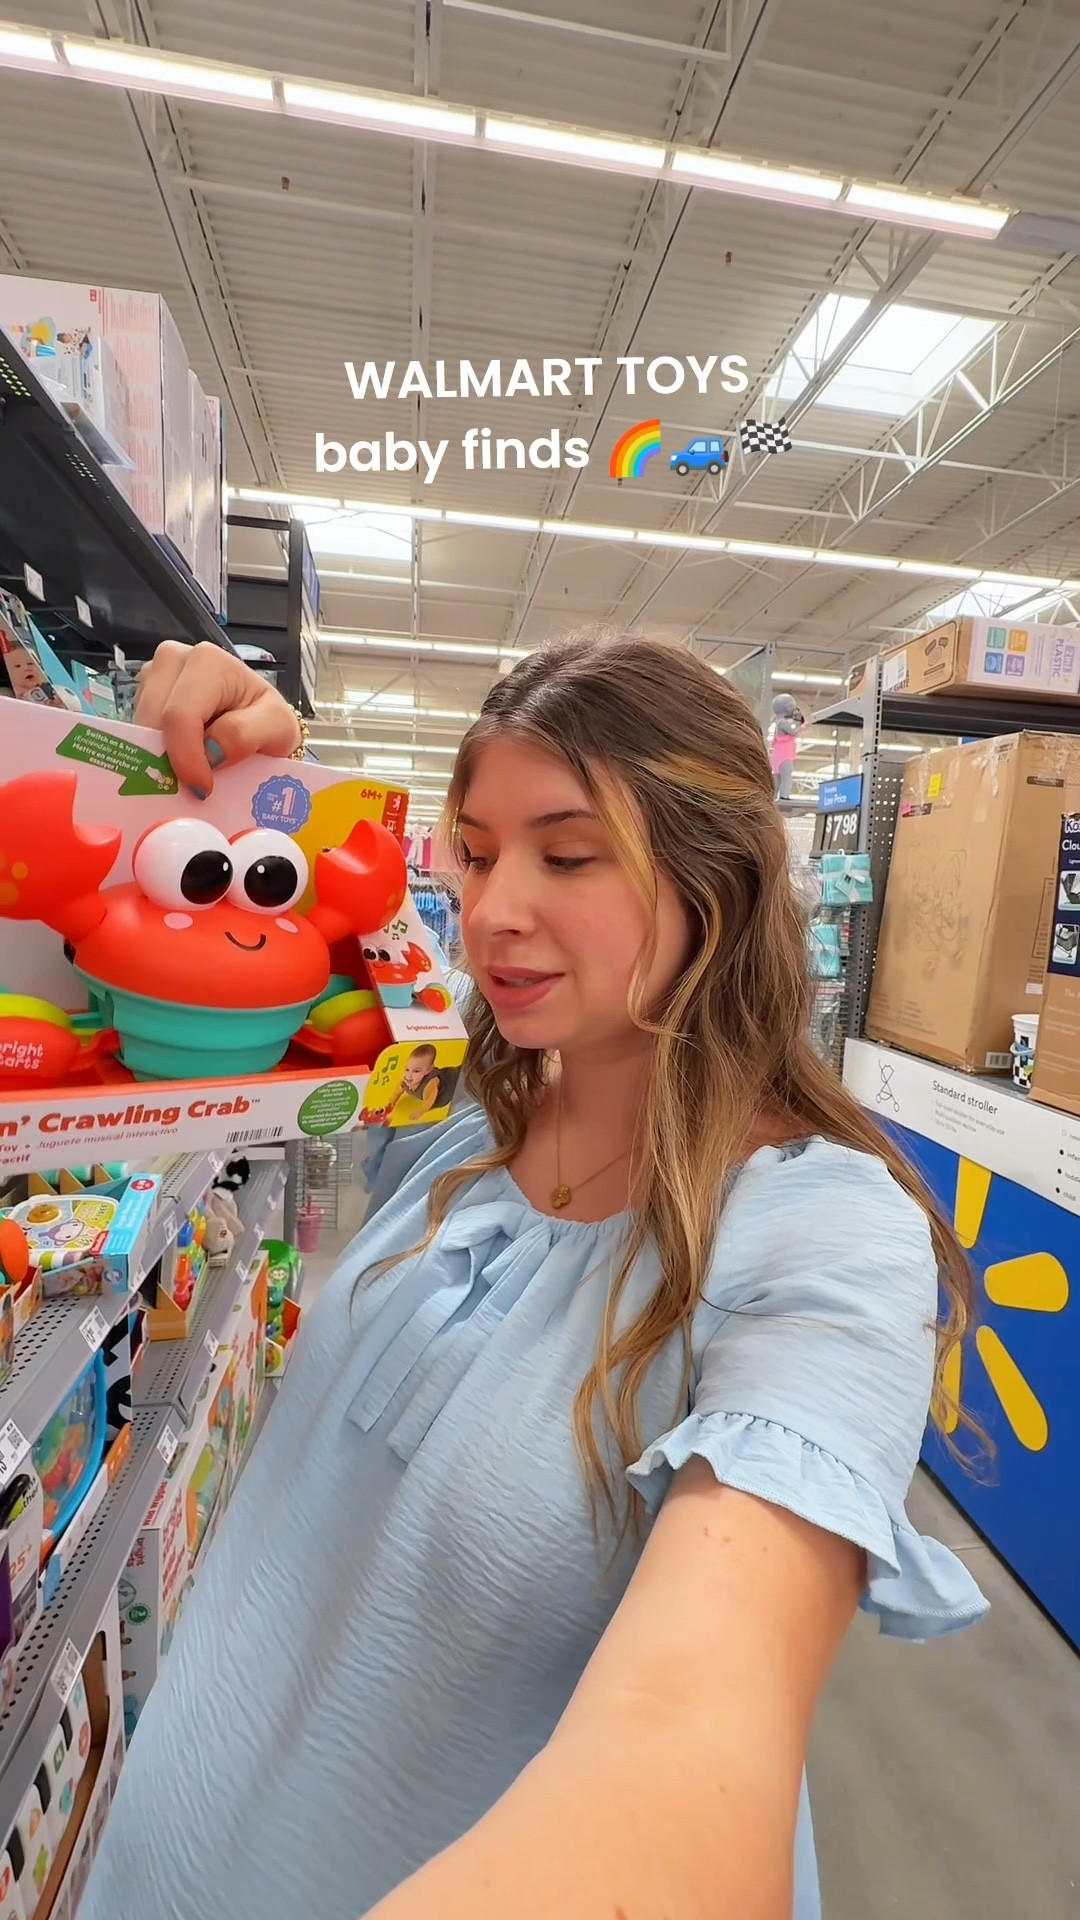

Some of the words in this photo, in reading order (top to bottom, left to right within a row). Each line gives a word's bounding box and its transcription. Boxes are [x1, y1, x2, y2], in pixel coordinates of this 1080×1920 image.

[1053, 638, 1065, 677] PLASTIC
[86, 729, 109, 744] Switch
[272, 787, 297, 816] #1
[360, 788, 383, 800] 6M+
[262, 812, 280, 822] BABY
[0, 1040, 43, 1058] right
[932, 1080, 966, 1103] Standard
[967, 1096, 998, 1115] stroller
[38, 1104, 181, 1132] Crawling
[36, 1138, 81, 1149] Juguete
[84, 1131, 124, 1144] musical
[125, 1127, 178, 1139] interactivo
[0, 1154, 30, 1165] actif
[136, 1537, 145, 1567] bright
